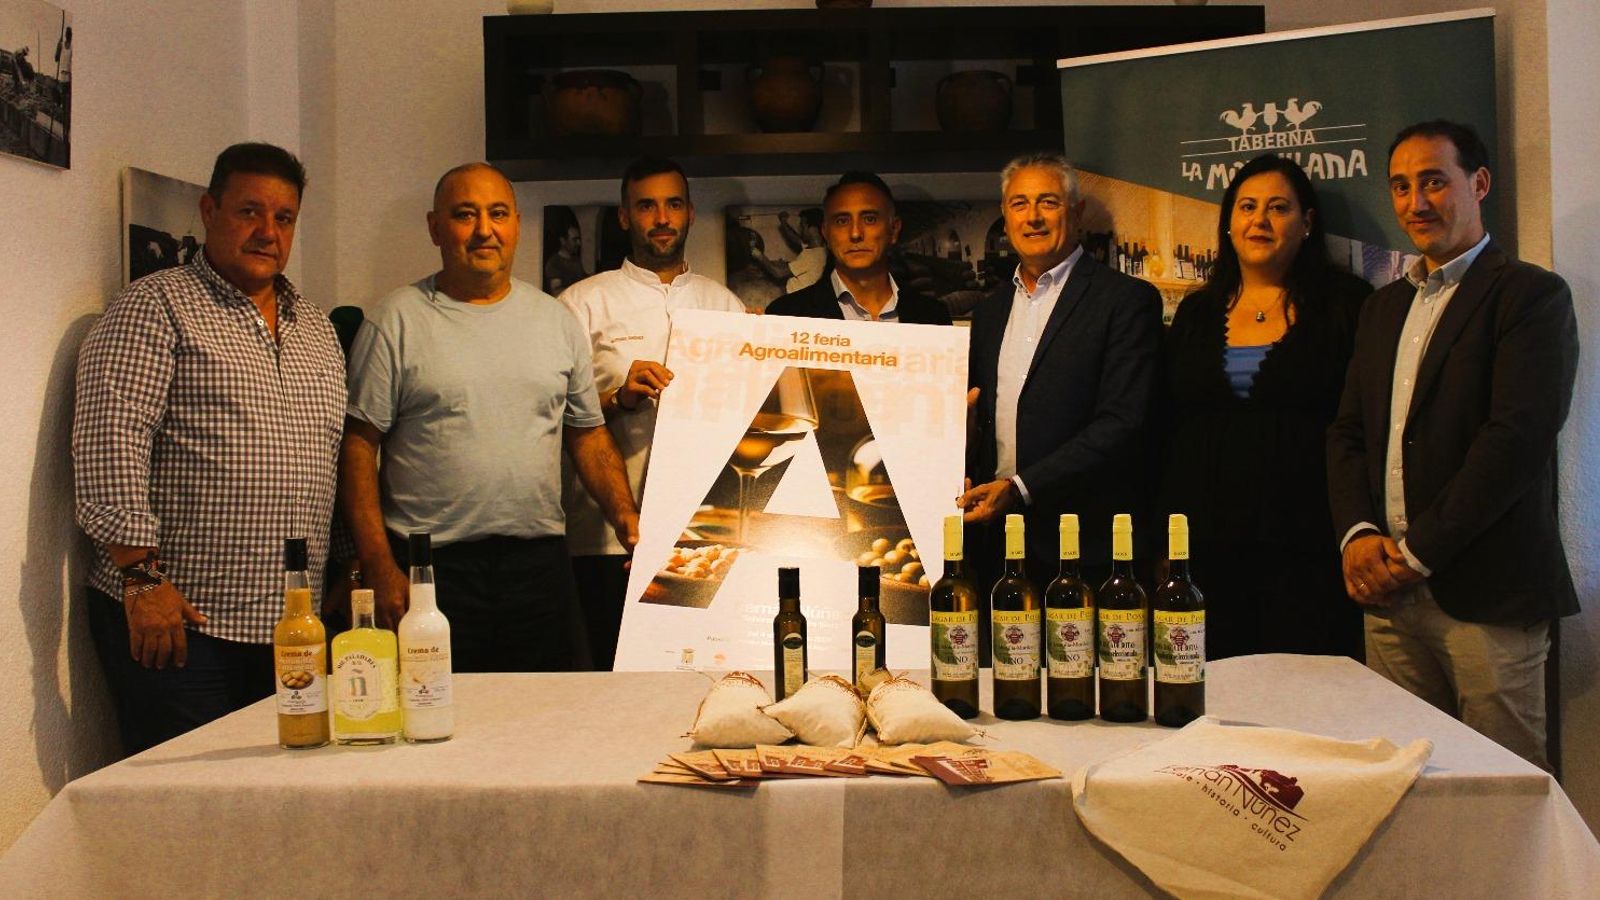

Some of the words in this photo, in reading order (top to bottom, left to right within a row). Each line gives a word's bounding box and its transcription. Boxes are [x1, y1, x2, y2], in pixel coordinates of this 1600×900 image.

[1227, 130, 1316, 152] TABERNA
[1181, 161, 1203, 182] LA
[790, 331, 810, 344] 12
[812, 333, 851, 347] feria
[738, 342, 898, 367] Agroalimentaria
[1251, 822, 1287, 852] cultura
